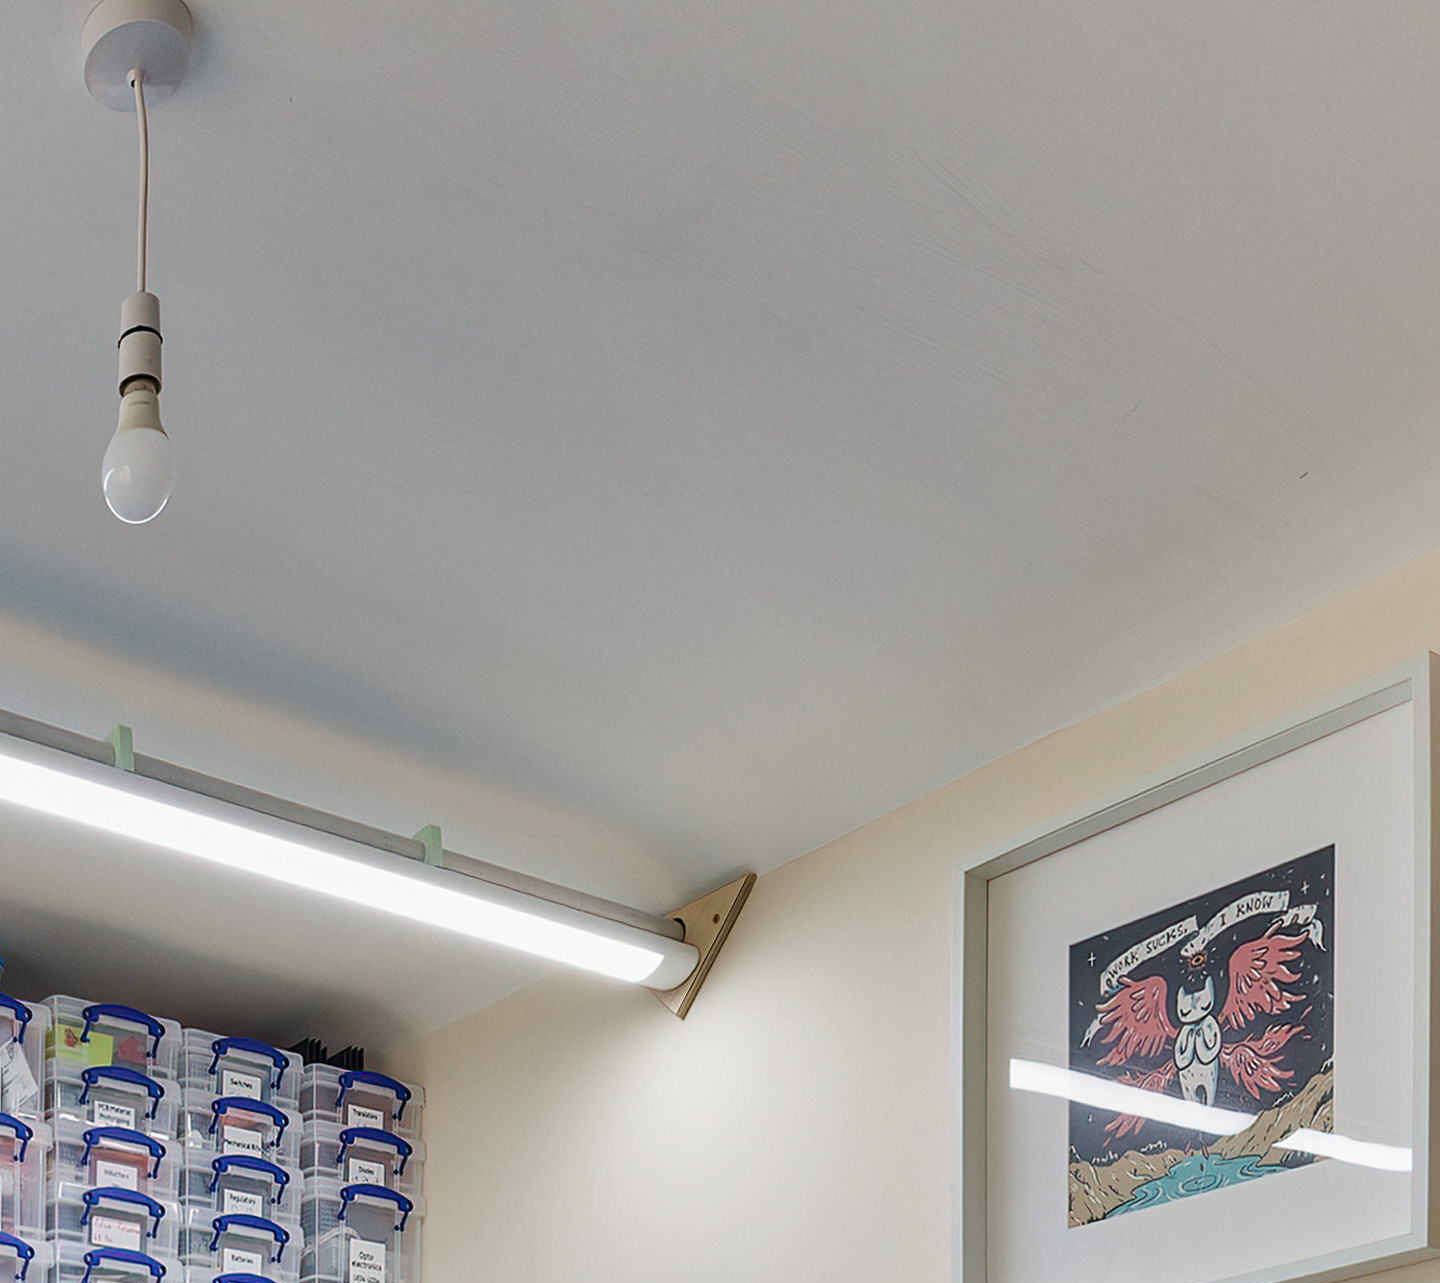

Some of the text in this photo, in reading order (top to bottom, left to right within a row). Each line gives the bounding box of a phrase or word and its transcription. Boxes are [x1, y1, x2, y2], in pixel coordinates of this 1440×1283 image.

[1220, 897, 1273, 926] I KNOW
[1109, 954, 1139, 979] WORK
